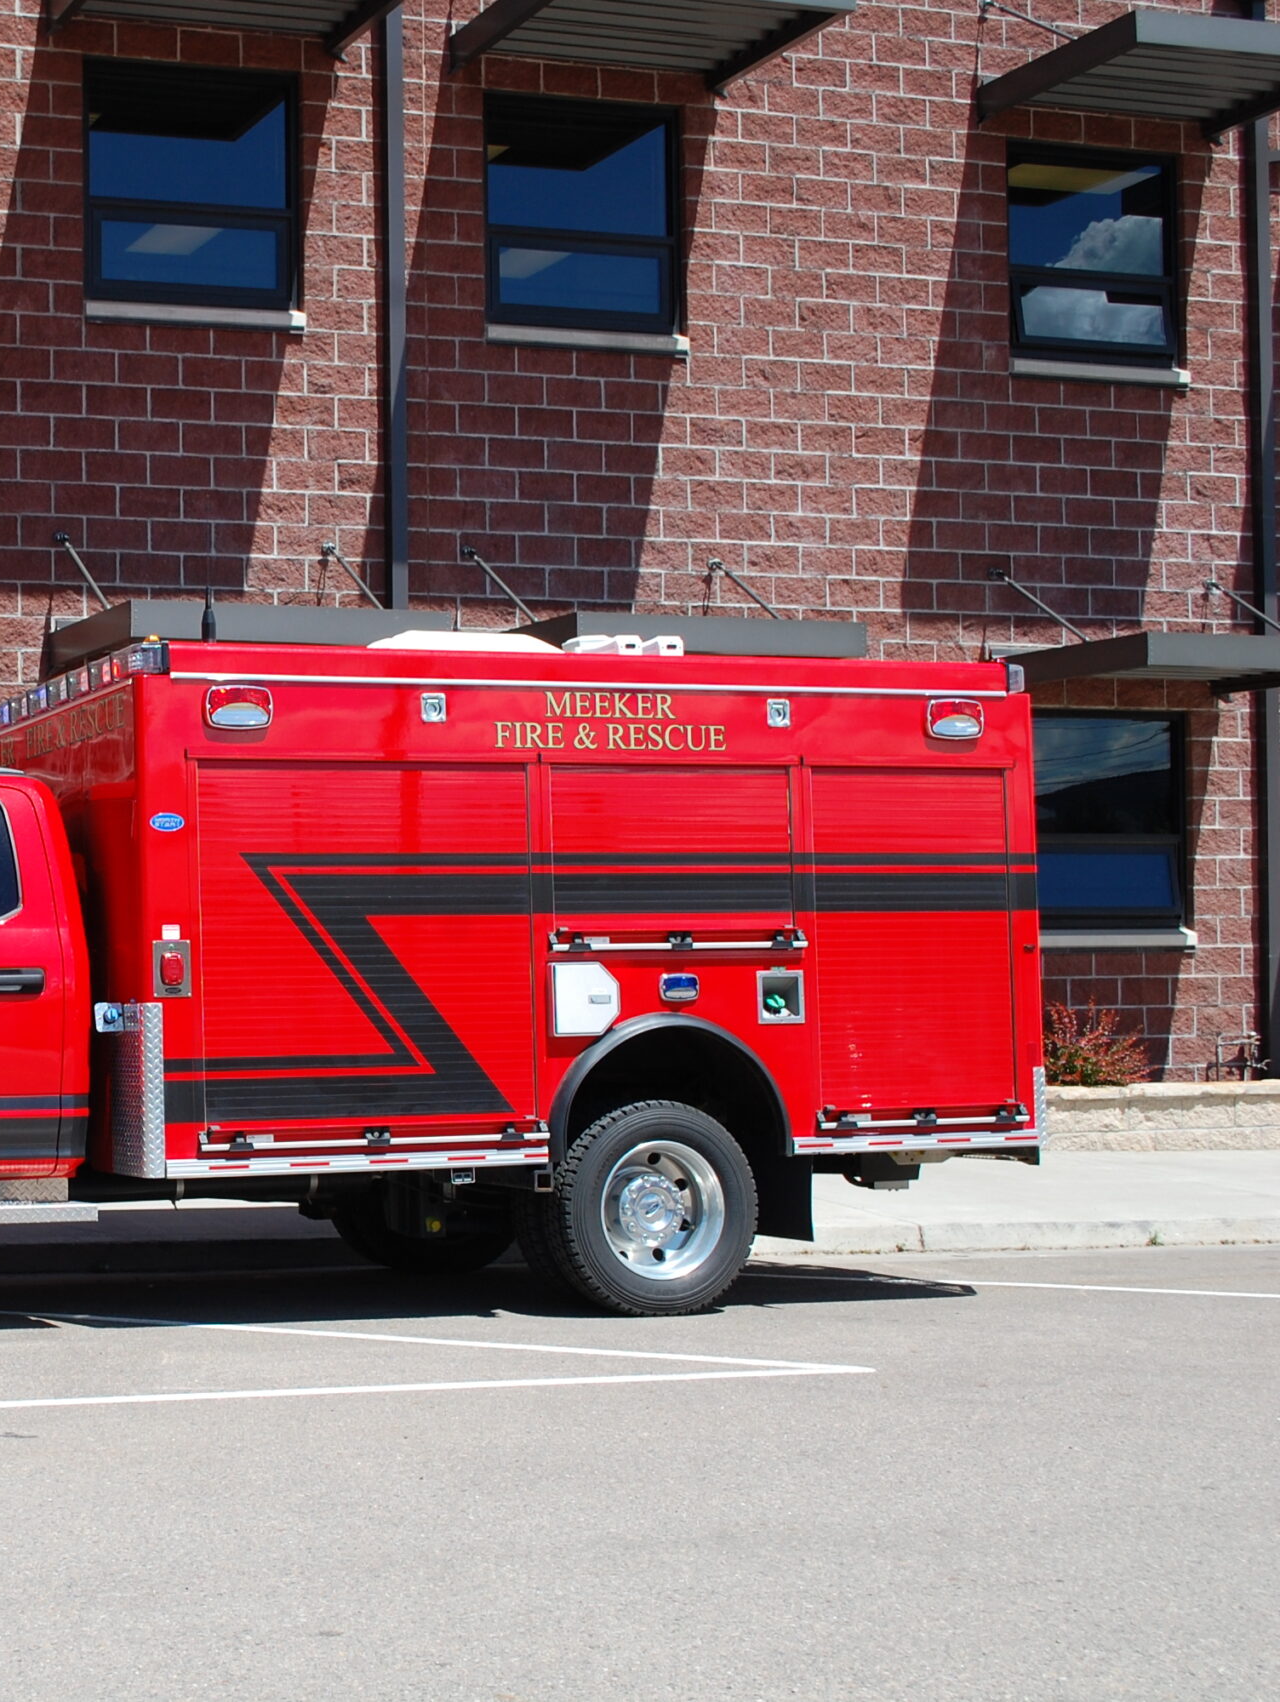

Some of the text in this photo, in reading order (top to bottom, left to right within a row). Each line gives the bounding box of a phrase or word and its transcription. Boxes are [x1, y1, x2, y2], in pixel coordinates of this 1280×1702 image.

[544, 690, 677, 719] MEEKER
[25, 721, 53, 760] FIRE
[69, 693, 126, 745] RESCUE
[494, 721, 727, 751] FIRE & RESCUE
